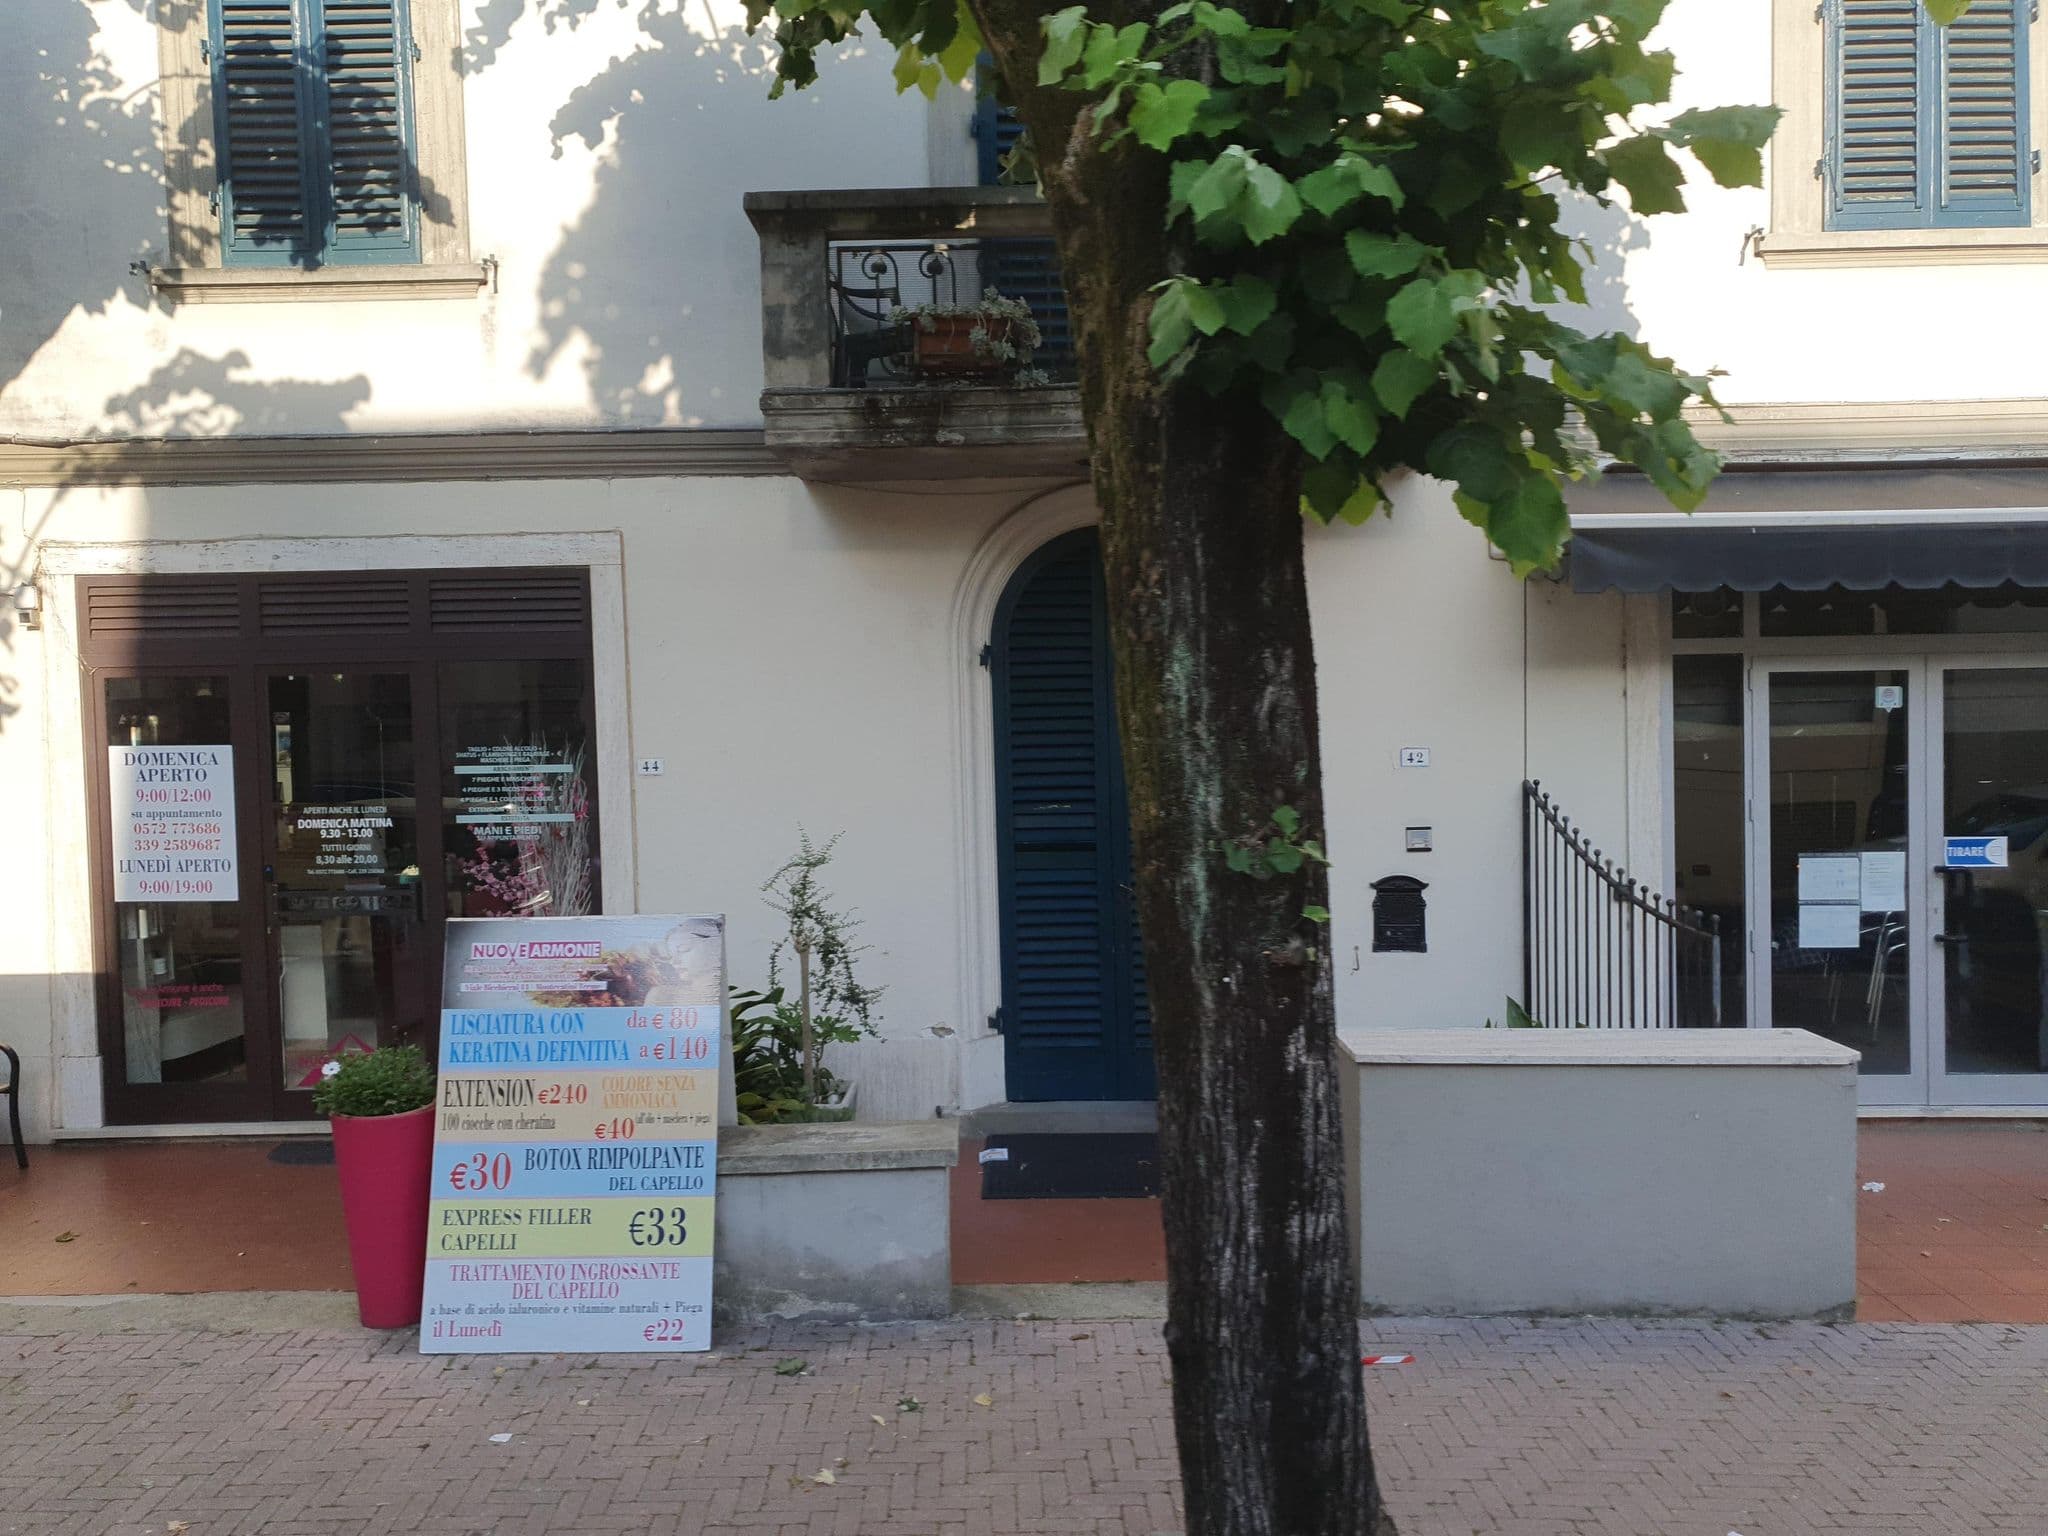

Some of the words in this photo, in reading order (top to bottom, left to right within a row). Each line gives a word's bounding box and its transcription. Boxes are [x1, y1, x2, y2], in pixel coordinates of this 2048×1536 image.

[124, 751, 219, 766] DOMENICA
[642, 760, 660, 772] 44
[1406, 751, 1425, 764] 42
[136, 768, 208, 782] APERTO
[136, 788, 212, 803] 9:00/12:00
[146, 808, 222, 820] appuntamento
[303, 806, 327, 814] APERTI
[328, 806, 353, 814] ANCHE
[354, 806, 361, 814] IL
[133, 822, 167, 835] 0572
[172, 822, 221, 835] 773686
[297, 818, 349, 829] DOMENICA
[350, 817, 393, 828] MATTINA
[473, 826, 503, 835] MANI
[504, 826, 512, 834] E
[514, 825, 542, 834] PIEDI
[320, 829, 341, 838] 9.30
[347, 828, 373, 838] 13.00
[134, 839, 159, 851] 339
[163, 838, 222, 851] 2589687
[321, 844, 343, 852] TUTTI
[346, 843, 372, 851] GIORNI
[1946, 846, 1985, 857] TIRARE
[119, 855, 171, 873] LUNEDÌ
[175, 858, 232, 873] APERTO
[336, 854, 353, 864] alle
[139, 879, 213, 895] 9:00/19:00
[473, 942, 528, 963] NUOVE
[530, 942, 600, 958] ARMONIE
[451, 1013, 545, 1036] LISCIATURA
[550, 1012, 585, 1035] CON
[626, 1010, 647, 1029] da
[652, 1013, 664, 1030] €
[669, 1007, 698, 1030] 80
[448, 1041, 532, 1063] KERATINA
[536, 1040, 630, 1062] DEFINITIVA
[640, 1045, 649, 1058] a
[653, 1036, 708, 1060] €140
[601, 1076, 653, 1092] COLORE
[657, 1074, 696, 1091] SENZA
[443, 1078, 536, 1108] EXTENSION
[537, 1083, 588, 1105] €240
[602, 1092, 678, 1109] AMMONIACA
[442, 1112, 460, 1131] 100
[461, 1112, 495, 1131] ciocche
[497, 1118, 513, 1130] con
[515, 1111, 556, 1130] cheratina
[594, 1117, 635, 1139] €40
[524, 1147, 583, 1171] BOTOX
[586, 1145, 704, 1170] RIMPOLPANTE
[449, 1152, 513, 1191] €30
[609, 1176, 637, 1191] DEL
[640, 1175, 703, 1191] CAPELLO
[442, 1208, 523, 1226] EXPRESS
[528, 1208, 593, 1225] FILLER
[629, 1207, 687, 1246] €33
[441, 1233, 518, 1251] CAPELLI
[449, 1263, 566, 1282] TRATTAMENTO
[570, 1262, 681, 1281] INGROSSANTE
[512, 1282, 544, 1300] DEL
[548, 1281, 620, 1300] CAPELLO
[438, 1304, 461, 1315] base
[464, 1303, 476, 1315] di
[478, 1302, 506, 1315] acido
[508, 1303, 560, 1315] ialuronico
[562, 1305, 569, 1314] e
[572, 1303, 617, 1314] vitamine
[619, 1301, 659, 1314] naturali
[675, 1301, 703, 1316] Piega
[433, 1320, 443, 1338] il
[448, 1319, 503, 1338] Lunedì
[643, 1318, 684, 1342] €22
